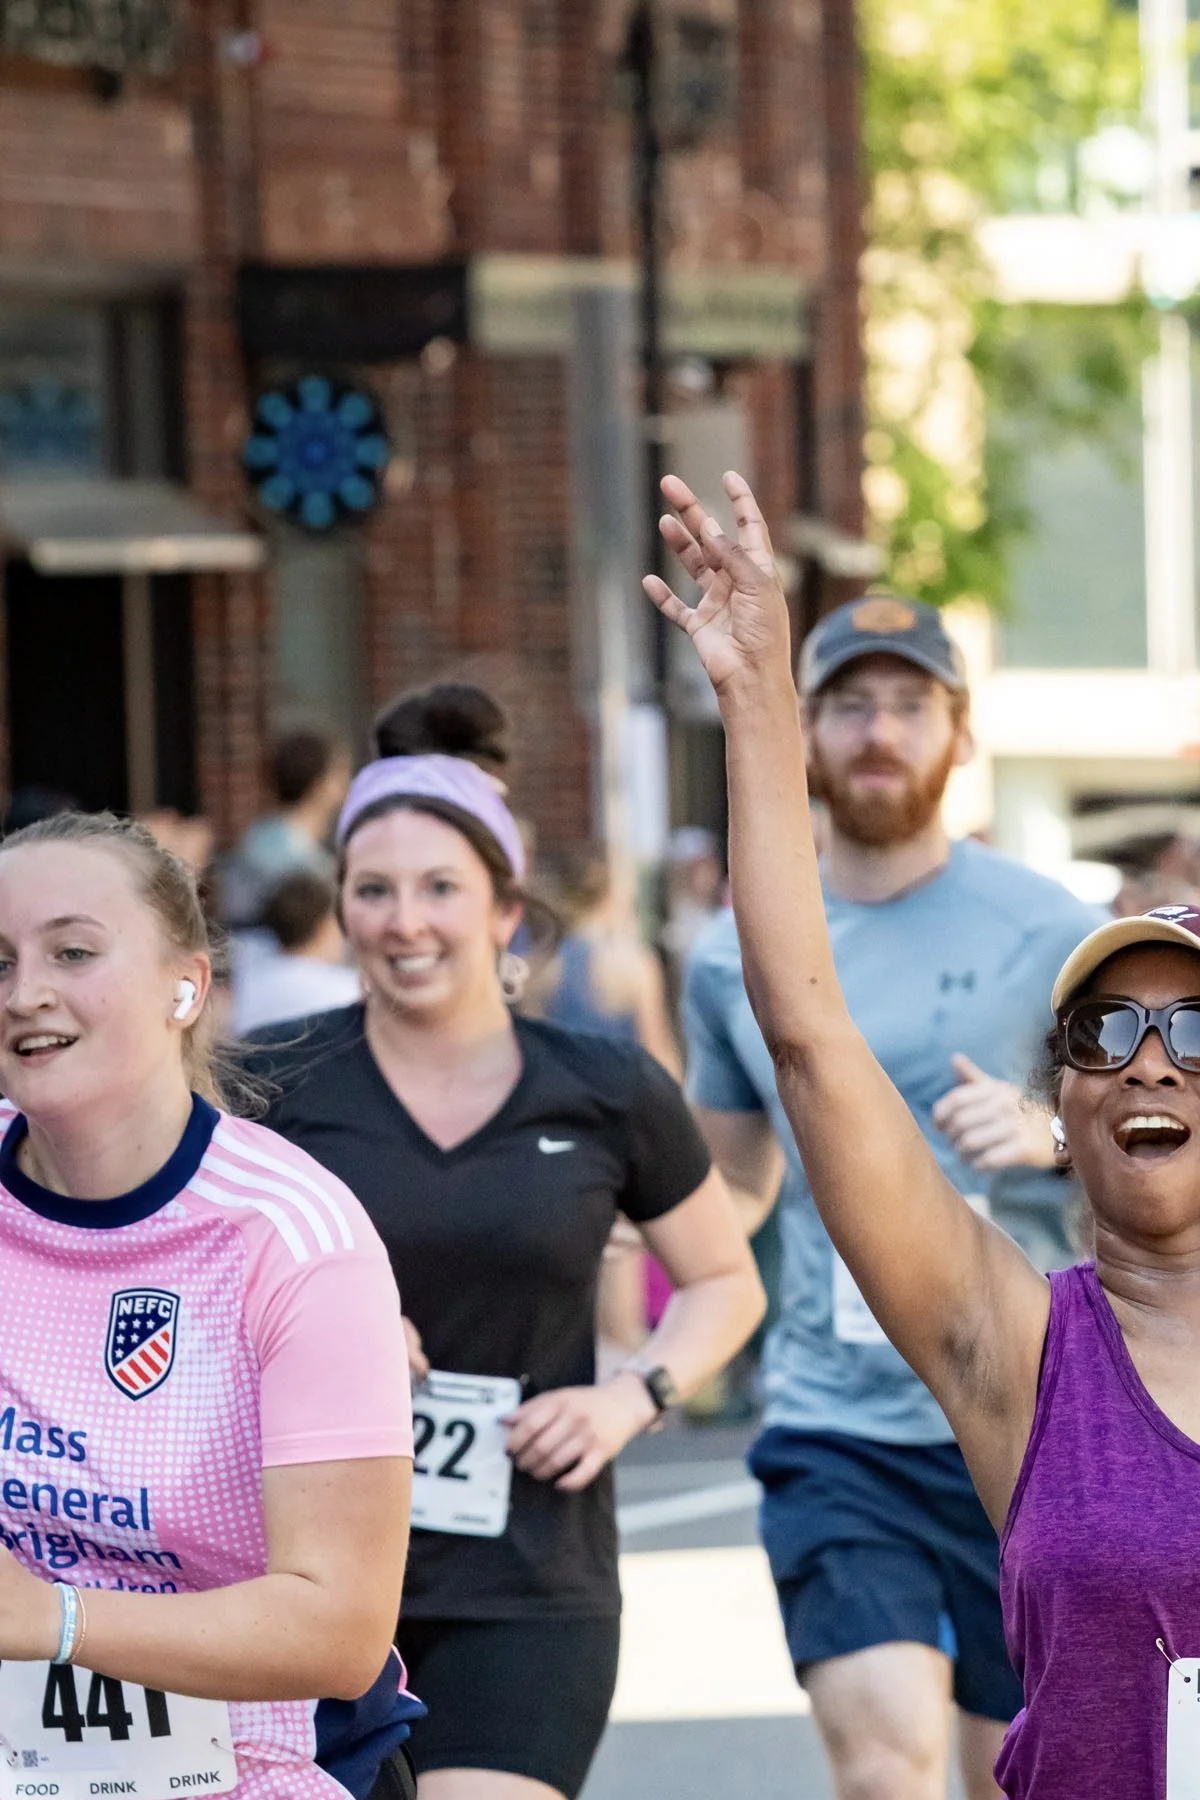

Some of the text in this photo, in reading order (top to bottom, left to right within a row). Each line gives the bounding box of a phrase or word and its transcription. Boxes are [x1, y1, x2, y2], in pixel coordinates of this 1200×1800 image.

[118, 1297, 172, 1319] NEFC
[2, 1478, 151, 1531] eneral
[15, 1770, 222, 1796] FOOD DRINK DRINK
